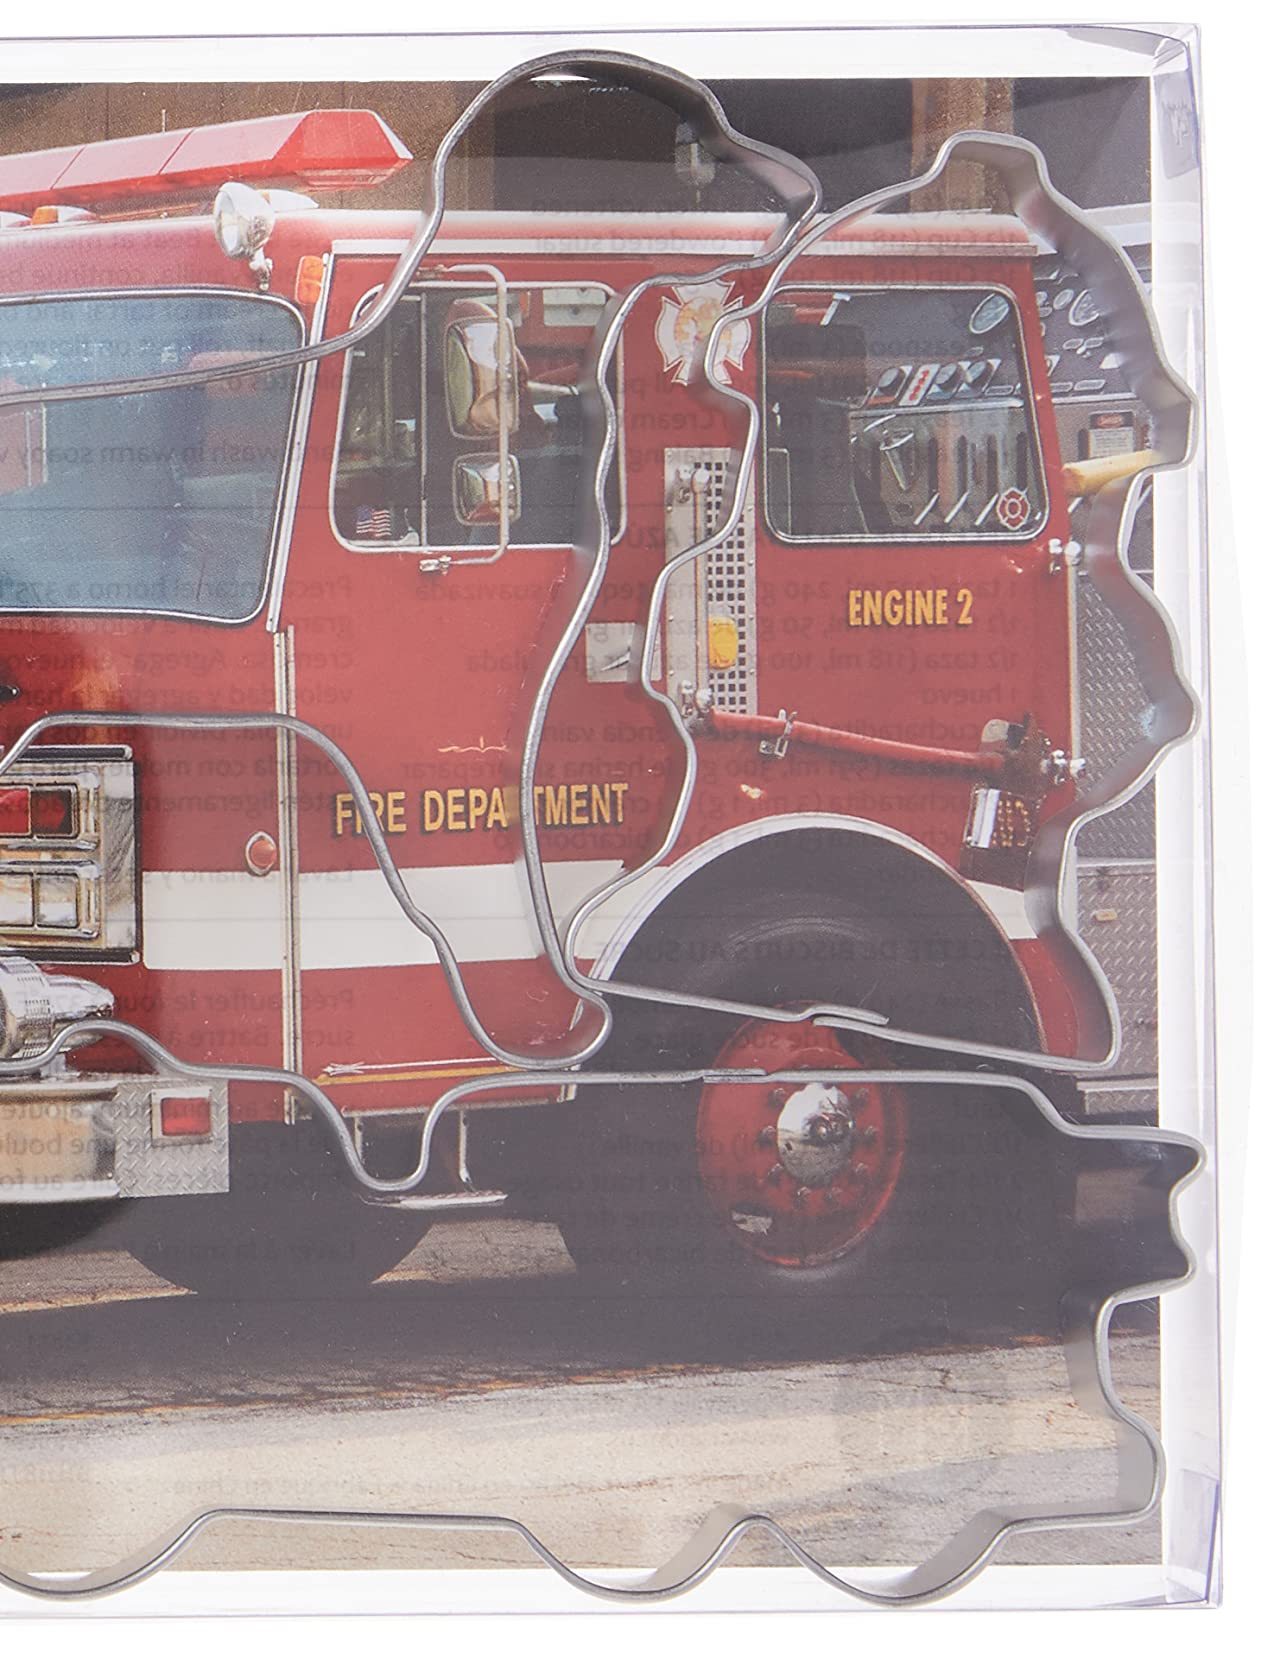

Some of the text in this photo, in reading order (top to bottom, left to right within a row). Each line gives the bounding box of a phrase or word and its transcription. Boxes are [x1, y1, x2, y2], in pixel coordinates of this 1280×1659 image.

[848, 588, 974, 626] ENGINE 2
[423, 782, 629, 833] DEPATMENT
